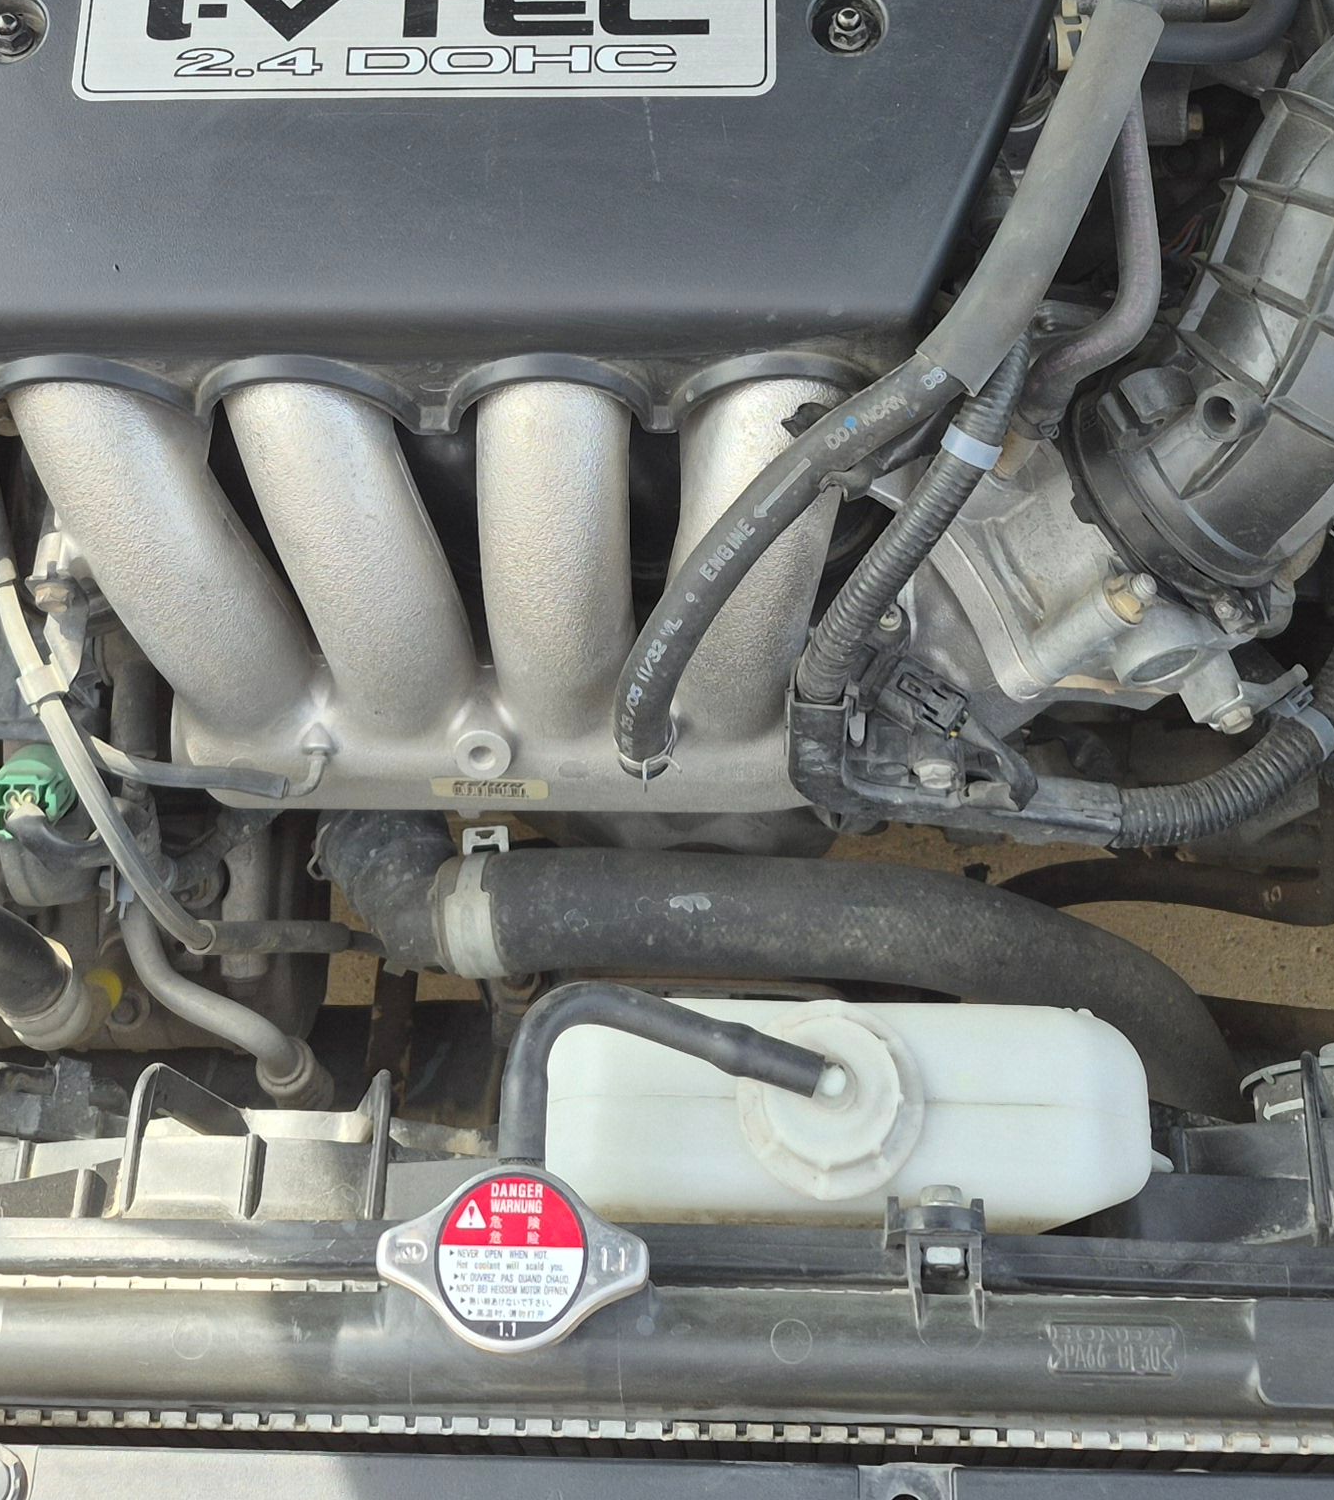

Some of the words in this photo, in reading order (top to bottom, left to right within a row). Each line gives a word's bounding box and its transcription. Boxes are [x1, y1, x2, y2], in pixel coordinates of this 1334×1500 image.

[174, 46, 324, 78] 2.4
[346, 43, 678, 76] DOHC
[698, 519, 758, 583] ENGINE
[491, 1182, 544, 1199] DANGER
[490, 1199, 543, 1214] WARNUNG
[457, 1249, 479, 1258] NEVER
[484, 1250, 503, 1259] OPEN
[509, 1250, 529, 1259] WHEN
[474, 1261, 501, 1270] coolant
[506, 1261, 520, 1270] will
[500, 1274, 514, 1283] PAS
[498, 1322, 517, 1338] 1.1
